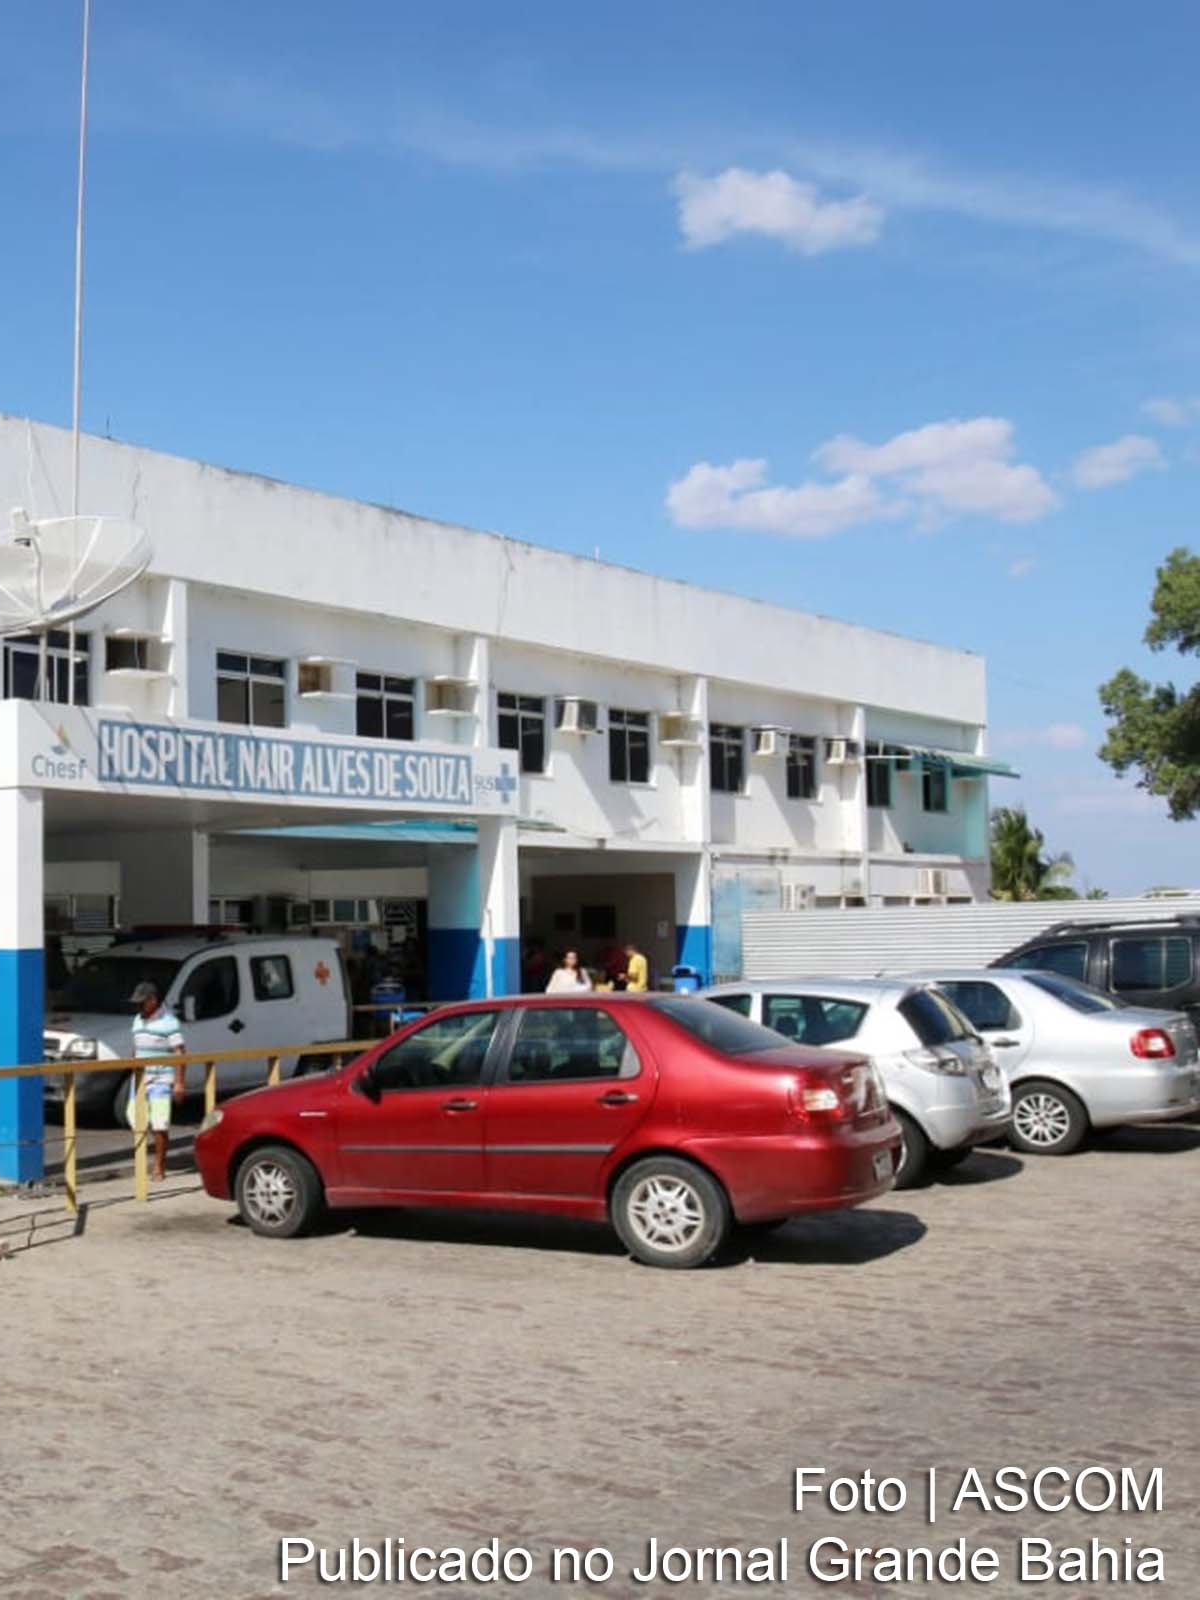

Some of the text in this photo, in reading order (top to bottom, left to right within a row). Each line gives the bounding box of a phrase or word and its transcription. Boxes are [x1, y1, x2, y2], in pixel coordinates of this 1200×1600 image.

[31, 754, 87, 780] Chesf
[101, 724, 470, 801] HOSPITAL NAIR ALVES DE SOUZA
